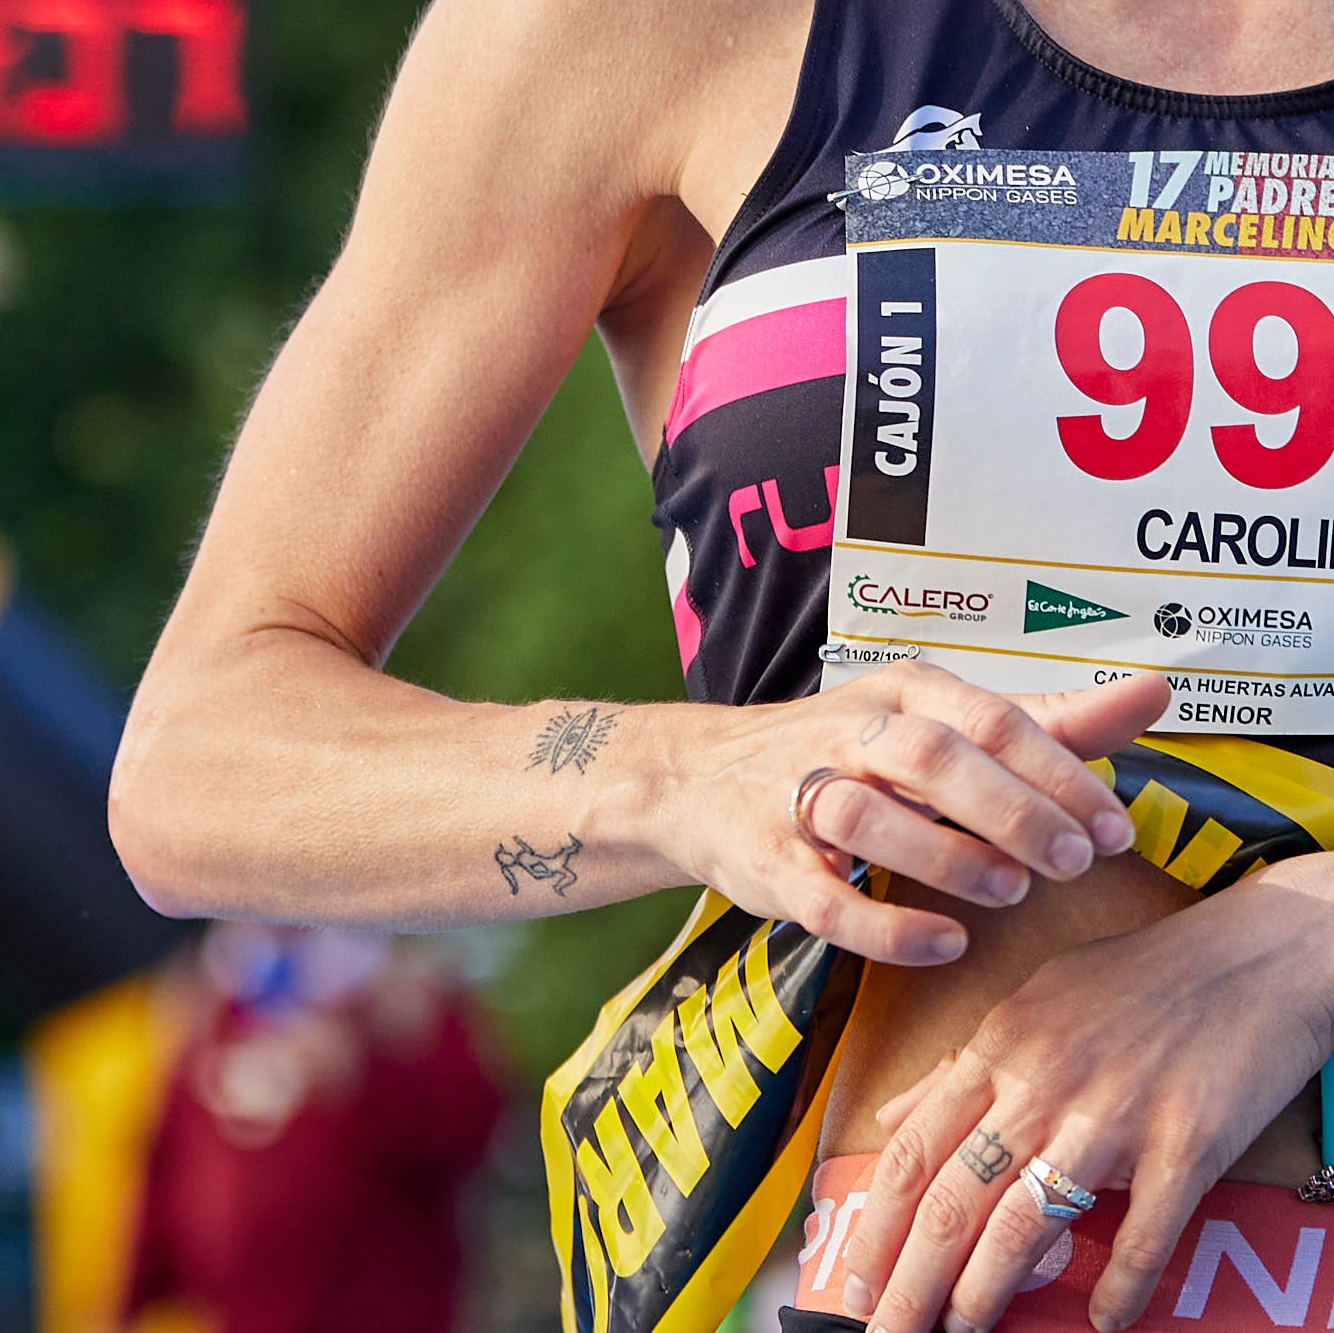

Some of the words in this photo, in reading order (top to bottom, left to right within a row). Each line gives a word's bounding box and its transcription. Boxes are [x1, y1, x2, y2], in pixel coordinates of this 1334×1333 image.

[916, 164, 1077, 186] OXIMESA
[1128, 150, 1204, 210] 17
[916, 188, 997, 202] NIPPON
[1006, 190, 1078, 205] GASES
[880, 301, 922, 317] 1
[868, 335, 922, 477] CAJÓN
[949, 612, 988, 623] GROUP
[1197, 606, 1313, 631] OXIMESA
[1195, 630, 1256, 646] NIPPON
[1261, 634, 1312, 649] GASES
[1196, 678, 1286, 698] HUERTAS
[1178, 702, 1273, 726] SENIOR
